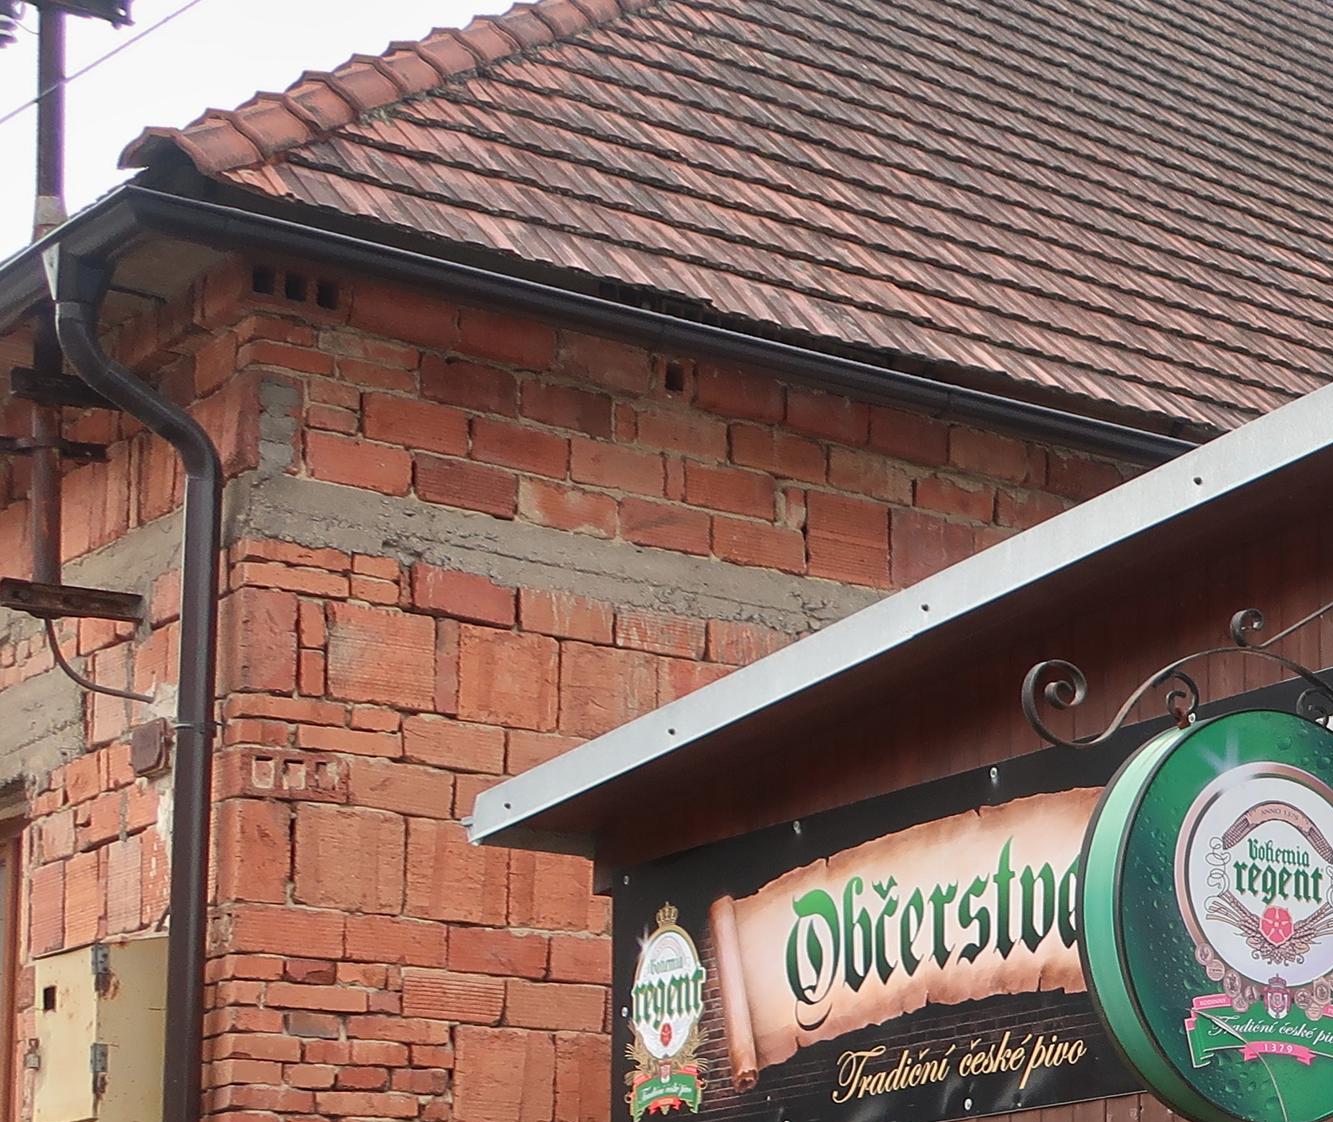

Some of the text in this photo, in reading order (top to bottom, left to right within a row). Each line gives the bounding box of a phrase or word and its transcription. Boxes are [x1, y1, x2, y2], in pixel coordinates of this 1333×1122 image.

[1247, 838, 1310, 868] Bohemia
[1233, 861, 1323, 905] regent
[785, 836, 1080, 1031] Občerstve
[633, 968, 704, 1031] regent
[832, 1031, 1088, 1104] Tradiční české pivo
[1264, 1043, 1293, 1054] 1379
